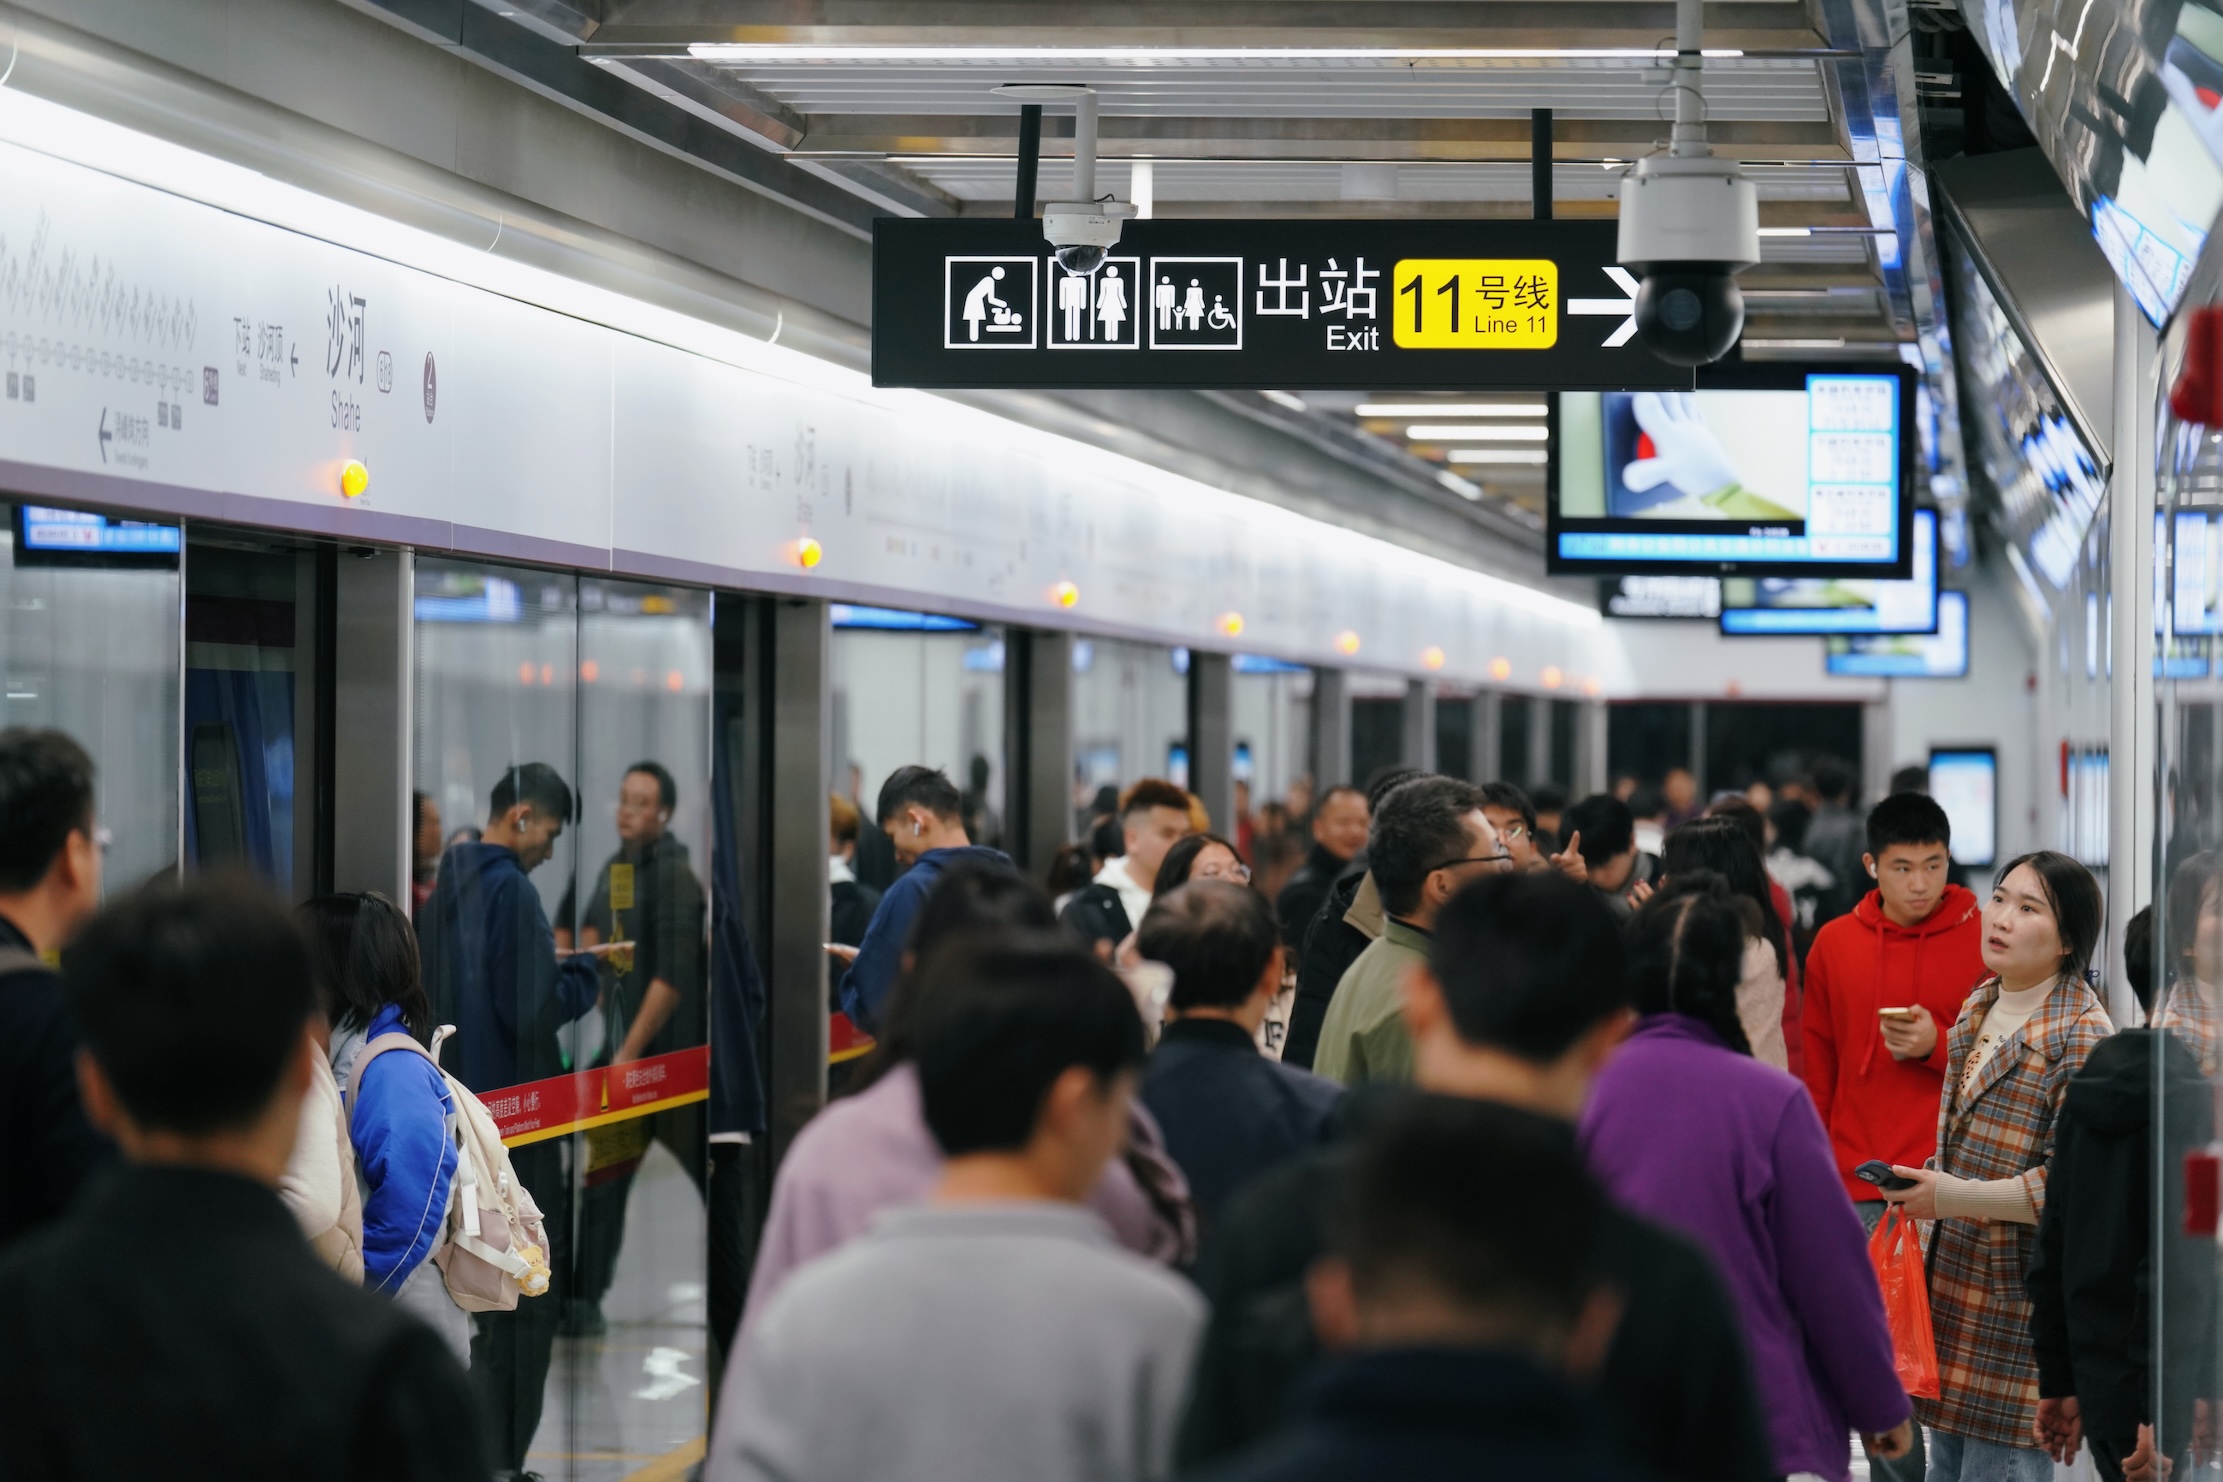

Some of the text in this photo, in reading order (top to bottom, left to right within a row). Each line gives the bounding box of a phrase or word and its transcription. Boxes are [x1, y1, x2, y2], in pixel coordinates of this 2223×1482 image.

[1255, 256, 1381, 320] 出站
[233, 316, 284, 364] 下站 沙河顶
[326, 284, 367, 385] 沙河
[1326, 324, 1380, 351] Exit
[1474, 315, 1547, 334] Line 11
[427, 353, 433, 389] 2
[331, 389, 361, 433] Shahe
